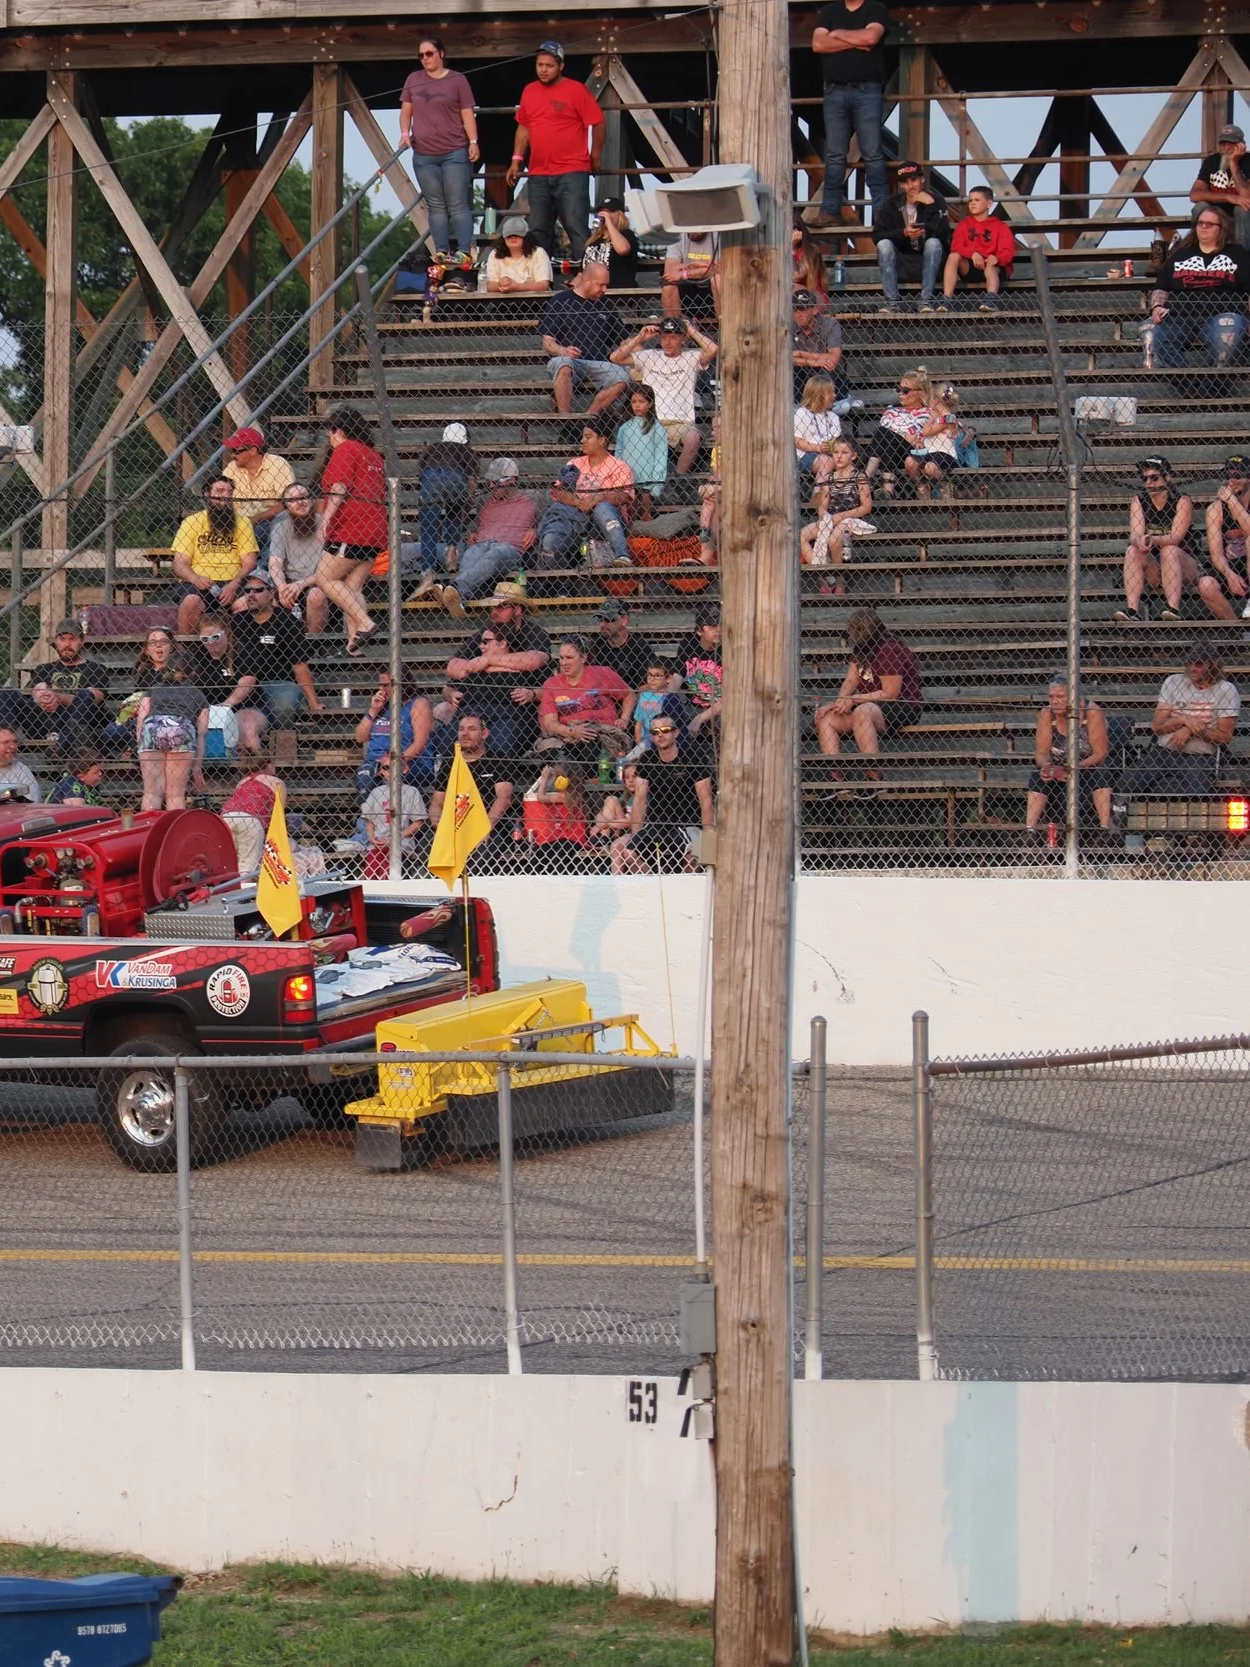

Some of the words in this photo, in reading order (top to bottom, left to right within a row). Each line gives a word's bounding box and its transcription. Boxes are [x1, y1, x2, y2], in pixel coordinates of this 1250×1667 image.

[209, 967, 232, 991] RAPID
[232, 969, 247, 989] FIRE
[210, 995, 247, 1015] PROTECTION
[629, 1381, 658, 1424] 53
